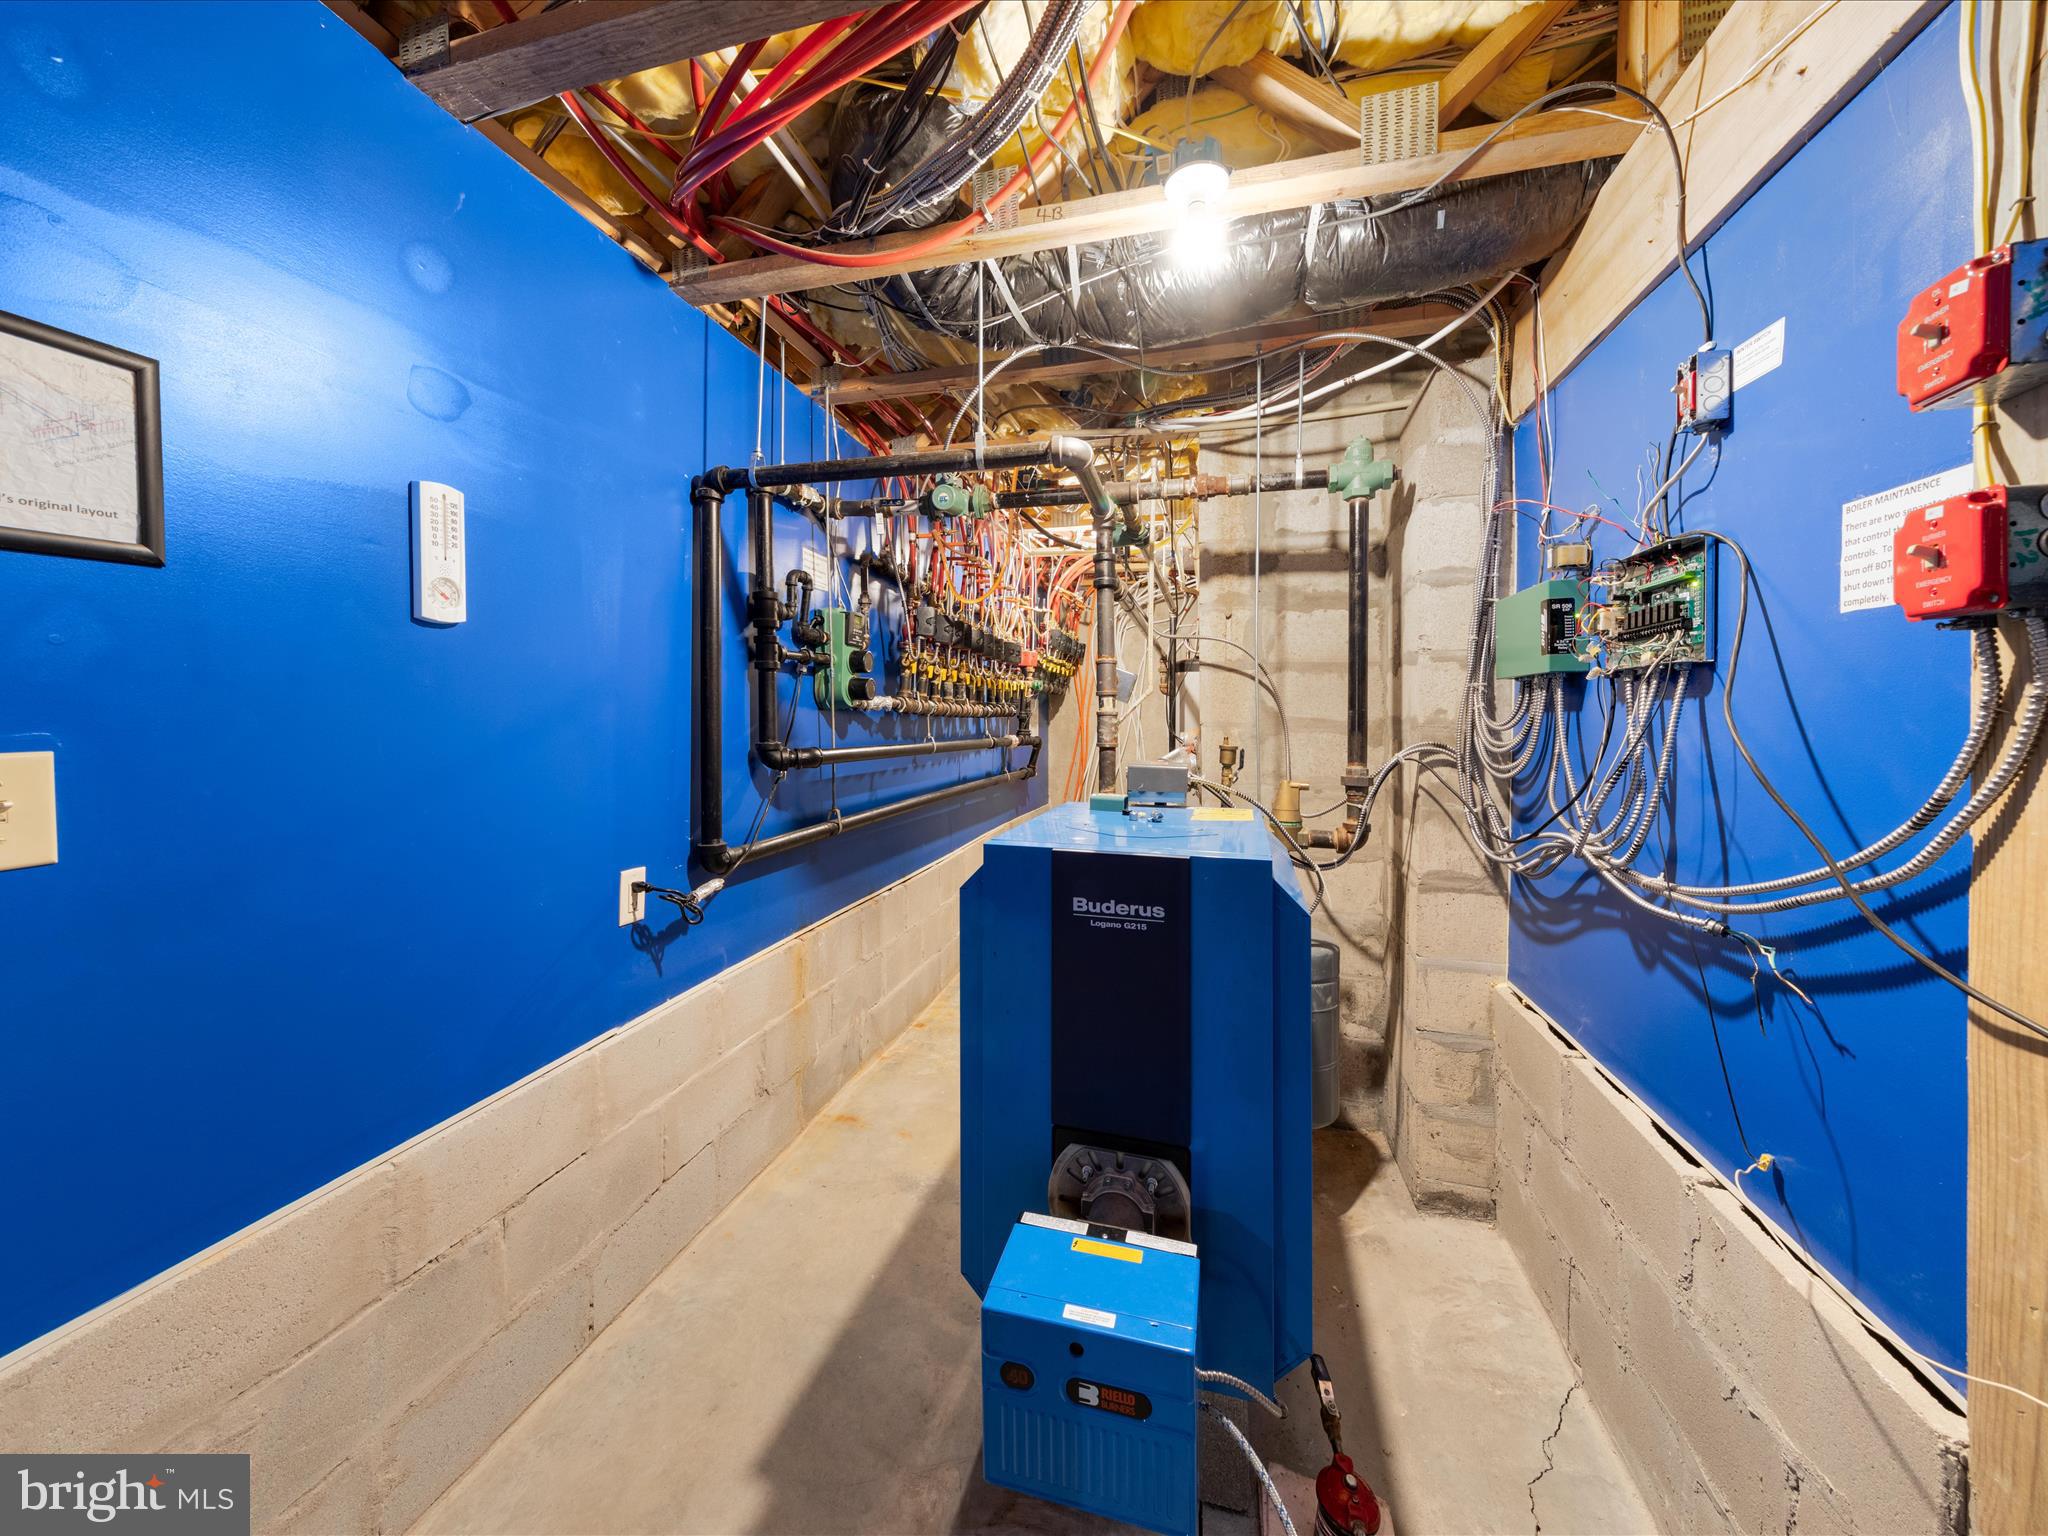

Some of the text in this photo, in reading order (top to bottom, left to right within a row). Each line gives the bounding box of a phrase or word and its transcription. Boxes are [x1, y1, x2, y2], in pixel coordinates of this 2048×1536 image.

[1918, 349, 1954, 373] EMERGENCY
[1924, 375, 1946, 391] SWITCH
[1846, 477, 1942, 514] BOILER MAINTANENCE
[0, 493, 119, 519] 's original layout
[1845, 520, 1868, 532] There
[1869, 516, 1882, 525] are
[1884, 511, 1900, 521] two
[1845, 537, 1861, 548] that
[1862, 529, 1891, 543] control
[1844, 544, 1892, 562] controls. To
[1844, 559, 1893, 577] turn off BOT
[1844, 582, 1860, 592] shut
[1862, 578, 1884, 588] down
[1916, 575, 1952, 588] EMERGENCY
[1843, 592, 1889, 607] completely.
[1922, 599, 1945, 609] SWITCH
[1072, 896, 1165, 918] Buderus
[1090, 919, 1148, 931] Logano G215
[1101, 1387, 1136, 1406] RIELLO
[1101, 1400, 1136, 1416] BURNERS
